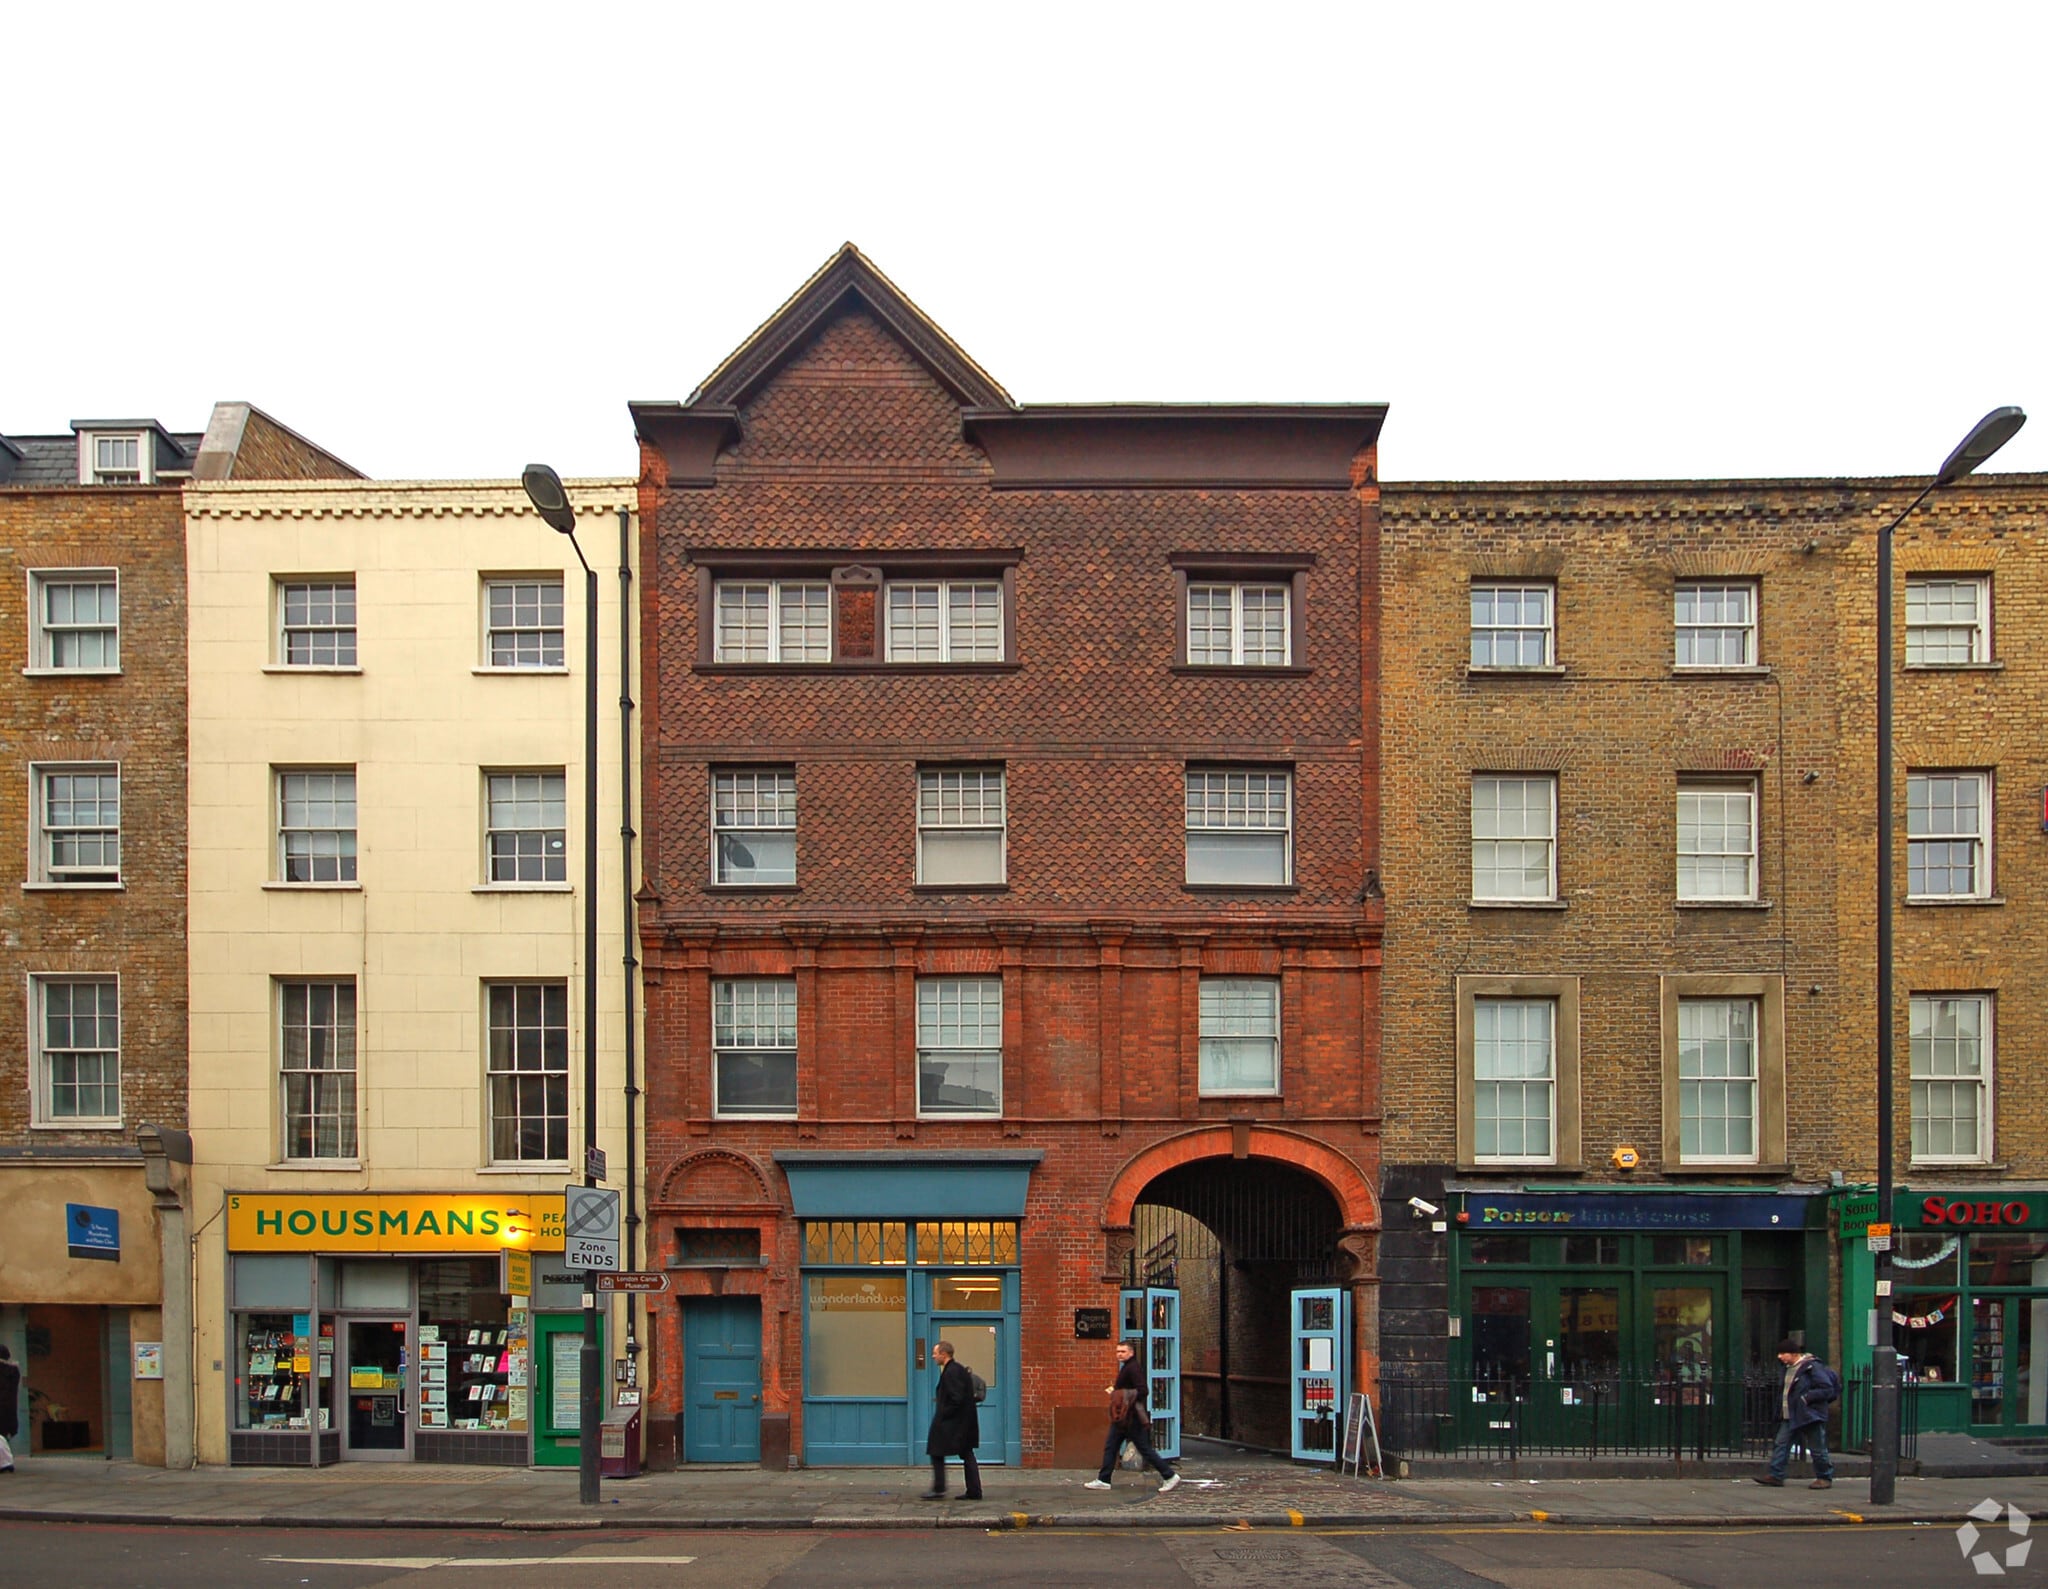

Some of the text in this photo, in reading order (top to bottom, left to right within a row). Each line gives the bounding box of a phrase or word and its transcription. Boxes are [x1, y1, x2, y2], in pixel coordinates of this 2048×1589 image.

[231, 1197, 240, 1209] 5
[1845, 1203, 1877, 1216] SOHO
[1483, 1207, 1571, 1223] Poison
[1922, 1196, 2030, 1225] SOHO
[256, 1209, 500, 1236] HOUSMANS
[1771, 1214, 1780, 1224] 9
[579, 1242, 606, 1252] Zone
[571, 1253, 613, 1266] ENDS
[640, 1275, 658, 1283] Canal
